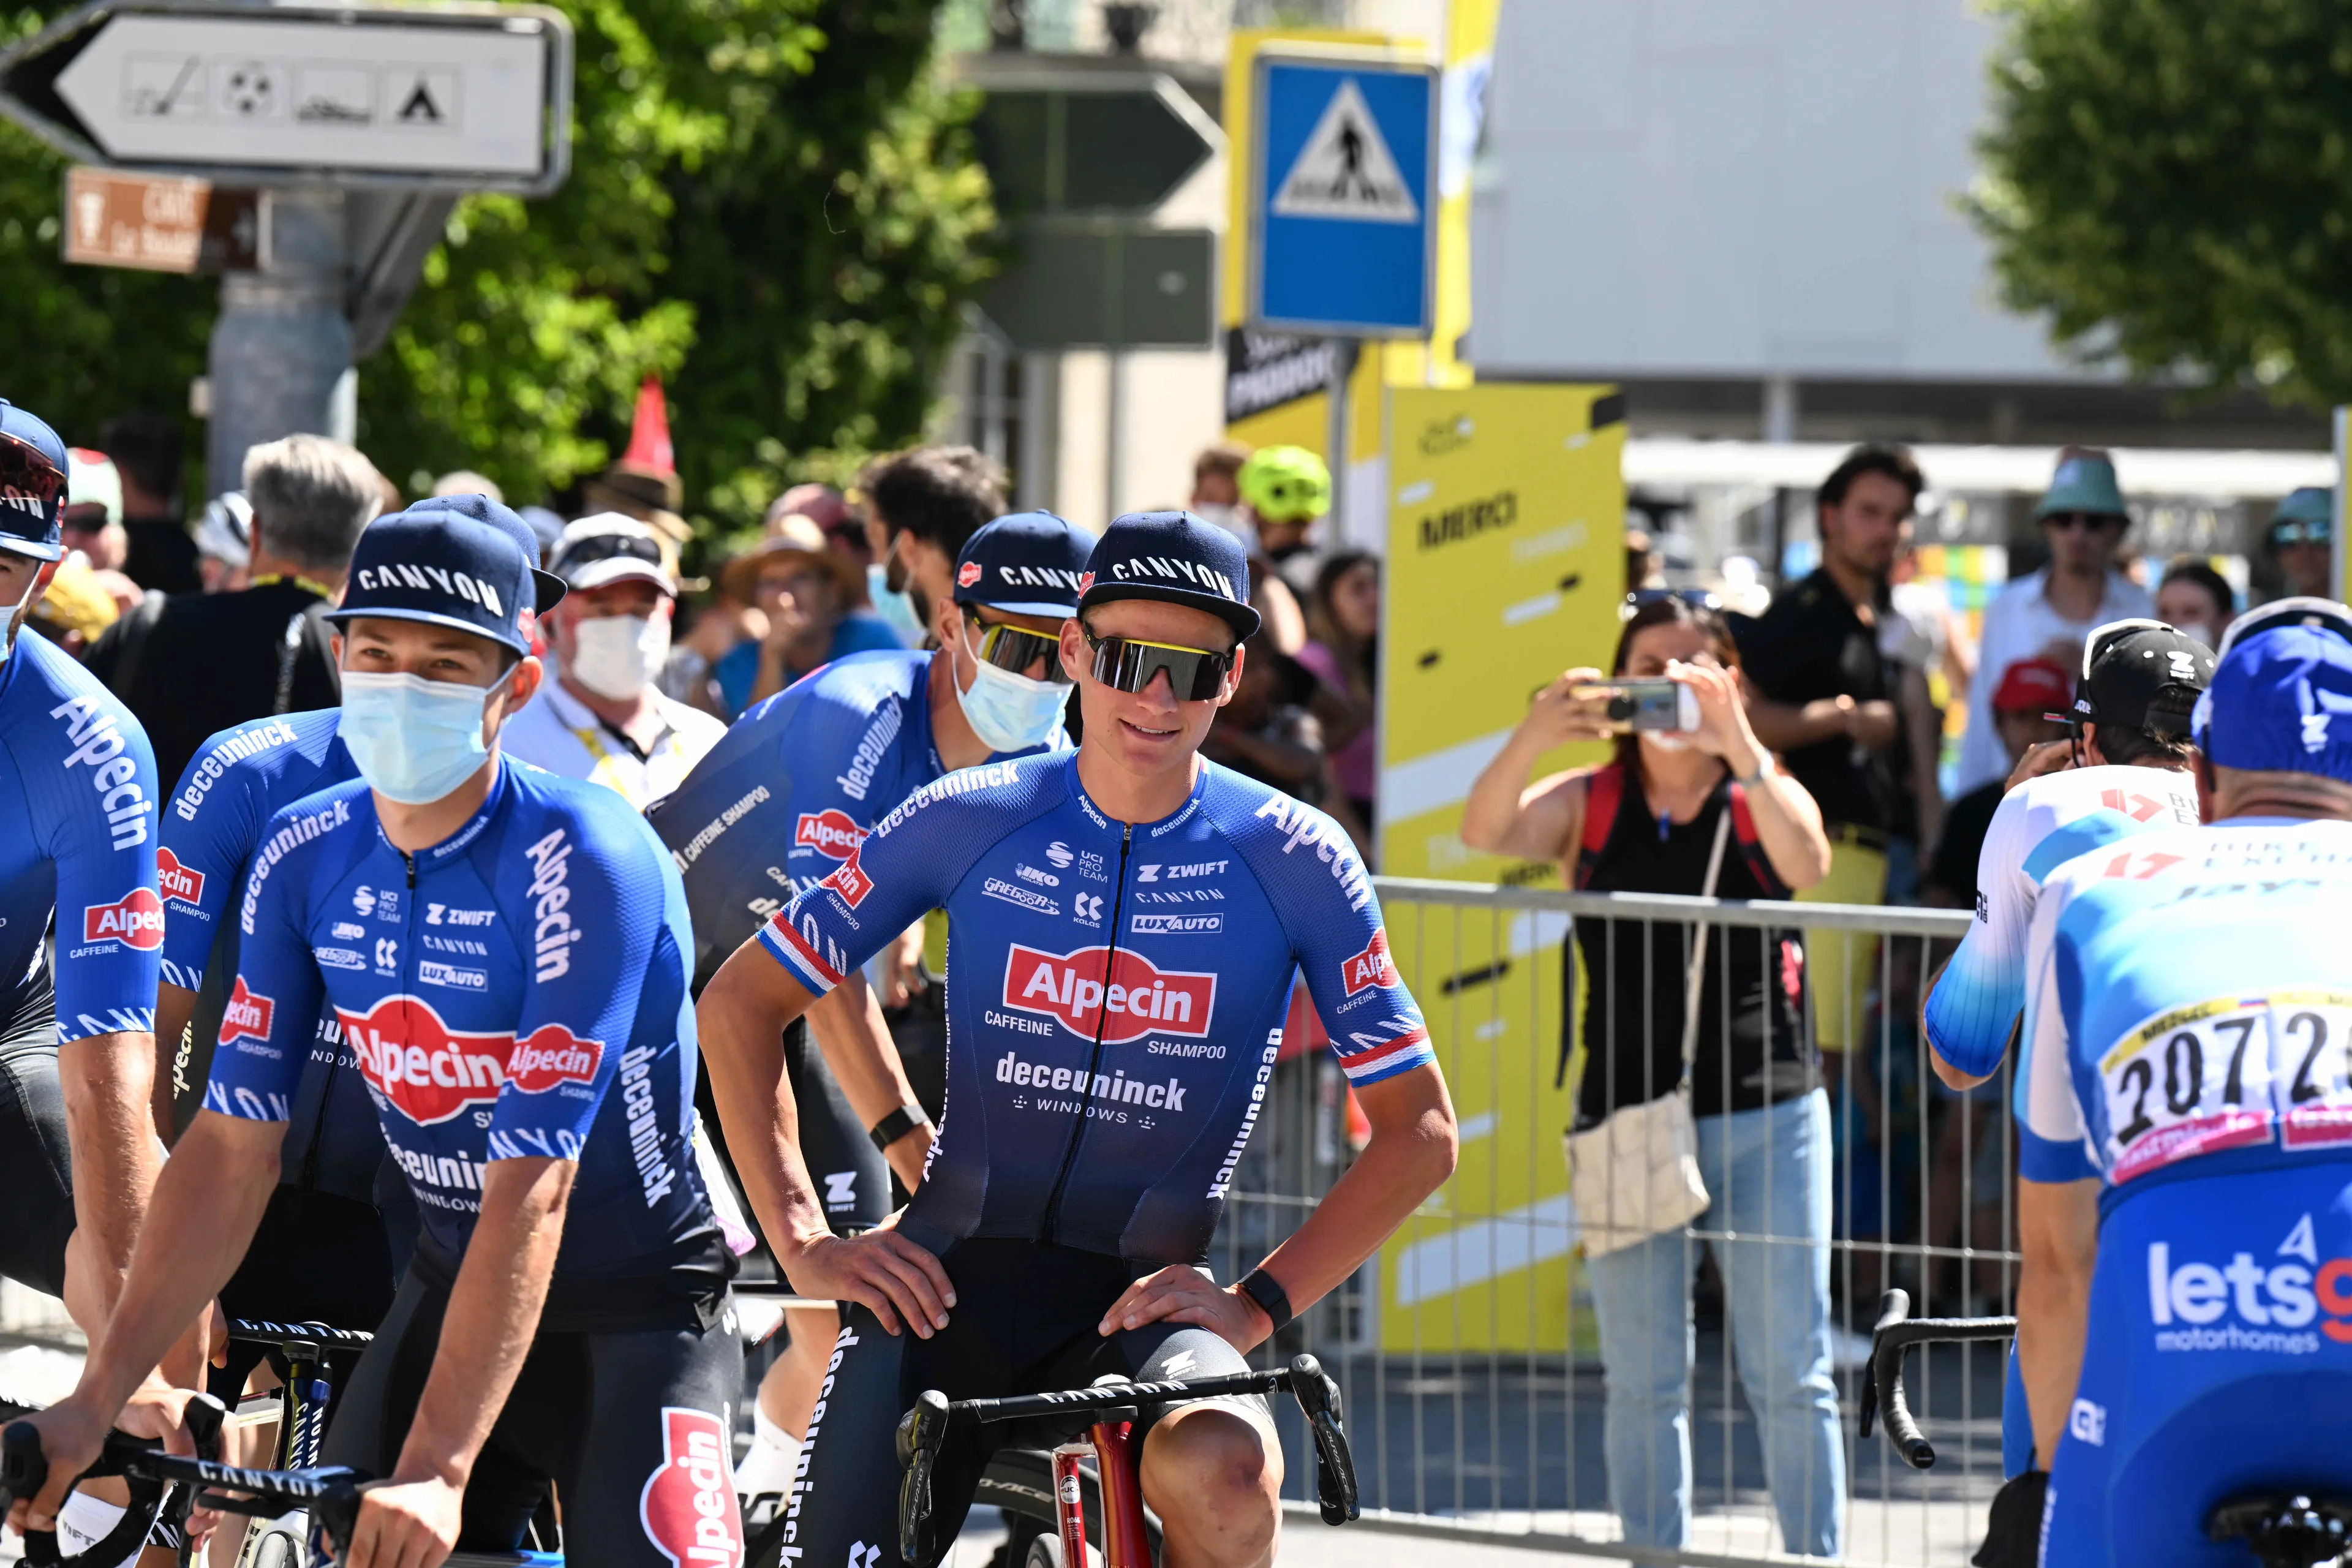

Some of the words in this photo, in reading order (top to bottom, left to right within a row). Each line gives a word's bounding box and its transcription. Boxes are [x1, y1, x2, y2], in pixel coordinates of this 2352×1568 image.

[358, 564, 503, 617] CANYON
[1000, 566, 1083, 591] CANY
[1112, 557, 1235, 601] CANYON
[836, 692, 904, 801] deceuninck
[50, 695, 152, 851] Alpecin
[176, 720, 298, 822] deceuninck
[878, 761, 1020, 838] deceuninck
[1078, 794, 1107, 830] Alpecin
[684, 818, 725, 861] CAFFEINE
[722, 785, 770, 826] SHAMPOO
[1151, 797, 1200, 838] deceuninck
[241, 799, 350, 935] deceuninck
[1079, 858, 1102, 872] PRO
[1081, 850, 1102, 864] UCI
[1167, 860, 1229, 878] ZWIFT
[1254, 793, 1371, 913] Alpecin
[157, 869, 192, 895] ecin
[1079, 867, 1108, 884] TEAM
[170, 901, 210, 921] SHAMPOO
[379, 901, 398, 912] PRO
[525, 828, 581, 983] Alpecin
[826, 893, 860, 930] SHAMPOO
[1135, 888, 1226, 903] CANYON
[377, 911, 401, 924] TEAM
[448, 908, 496, 927] ZWIFT
[70, 944, 119, 959] CAFFEINE
[423, 935, 488, 956] CANYON
[1022, 962, 1192, 1023] Alpecin
[1336, 990, 1377, 1014] CAFFEINE
[985, 1010, 1054, 1037] CAFFEINE
[311, 1049, 361, 1070] NDOW
[348, 1024, 504, 1095] Alpecin
[507, 1043, 589, 1079] Alpecin
[1147, 1041, 1226, 1059] SHAMPOO
[996, 1051, 1187, 1112] deceuninck
[2117, 1017, 2256, 1147] 207
[1036, 1098, 1128, 1123] WINDOWS
[1206, 1028, 1283, 1200] deceuninck
[828, 1203, 856, 1213] ZWIFT
[236, 1319, 374, 1341] CANYON
[2155, 1322, 2320, 1355] motorhomes
[1168, 1365, 1196, 1380] ZWIFT
[1038, 1380, 1189, 1404] CANYON
[288, 1402, 309, 1471] CANYO
[307, 1406, 323, 1470] NYON
[1325, 1430, 1351, 1494] DURA-ACE
[910, 1468, 924, 1535] DURA-ACE
